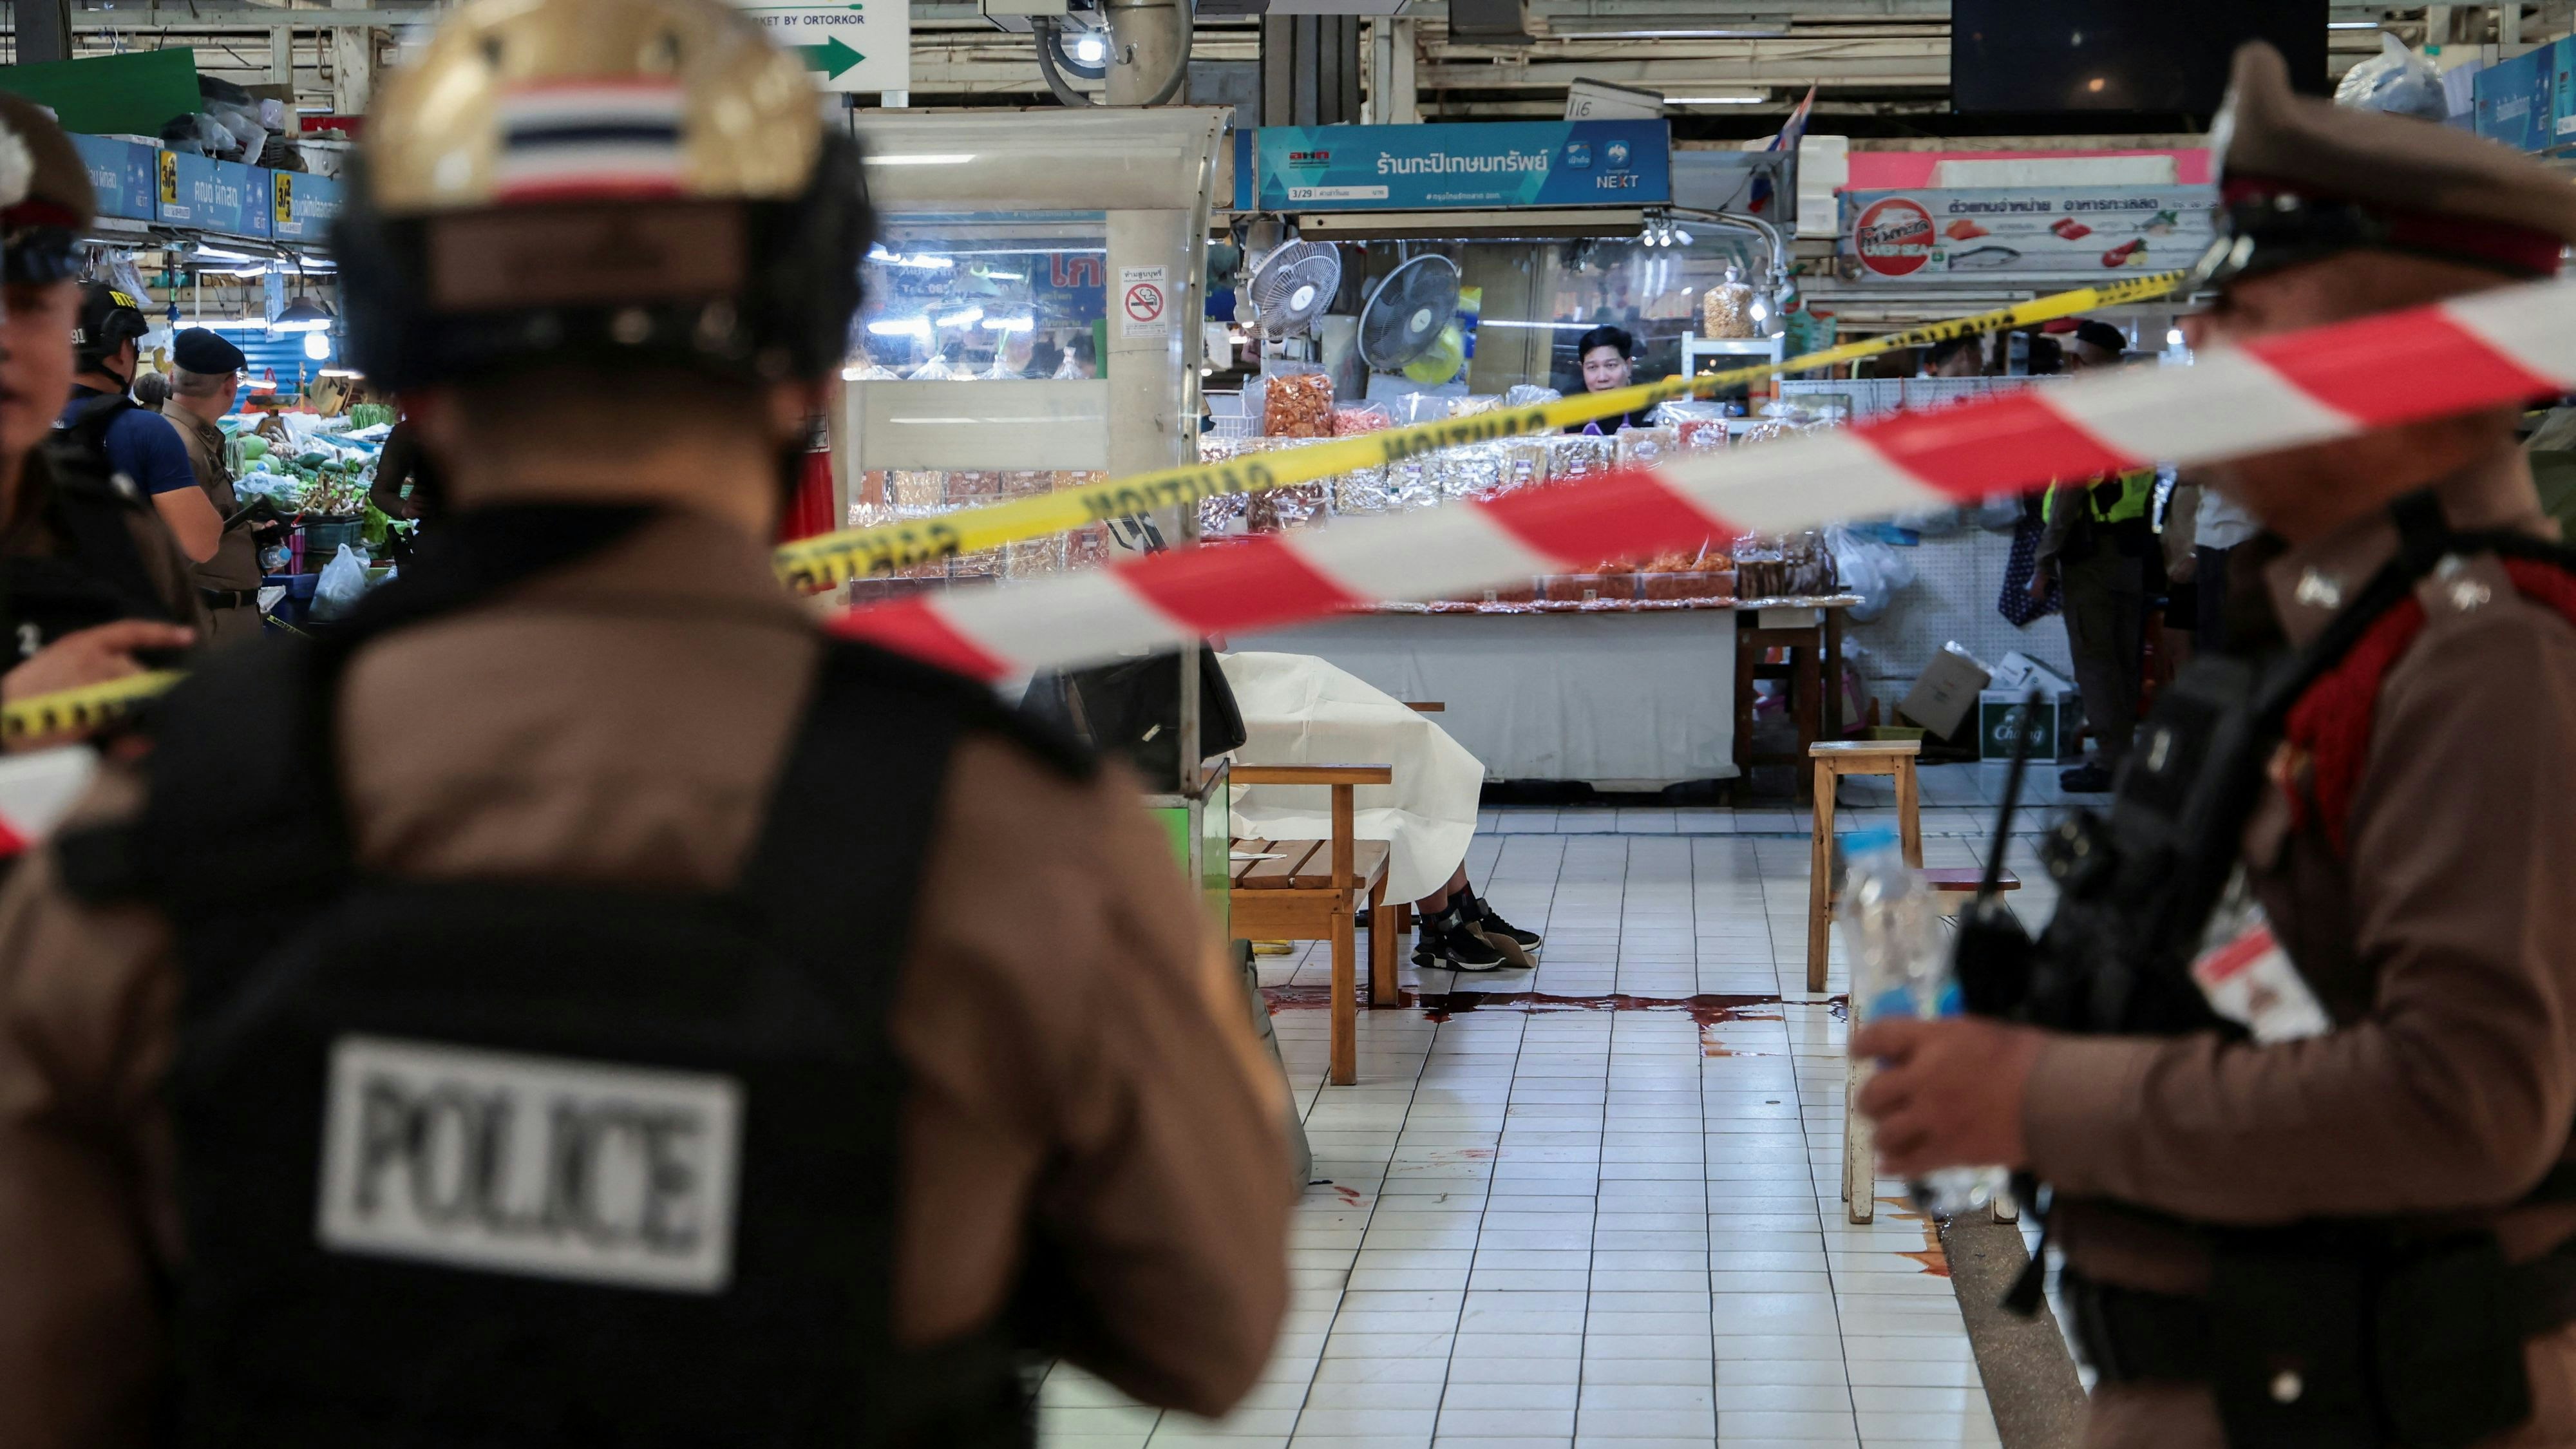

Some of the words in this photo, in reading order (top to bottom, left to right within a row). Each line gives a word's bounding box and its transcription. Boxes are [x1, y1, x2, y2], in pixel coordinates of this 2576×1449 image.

[784, 16, 798, 26] BY
[803, 15, 865, 25] ORTORKOR
[1596, 175, 1639, 188] NEXT
[1292, 189, 1312, 198] 3/29
[356, 1070, 706, 1260] POLICE
